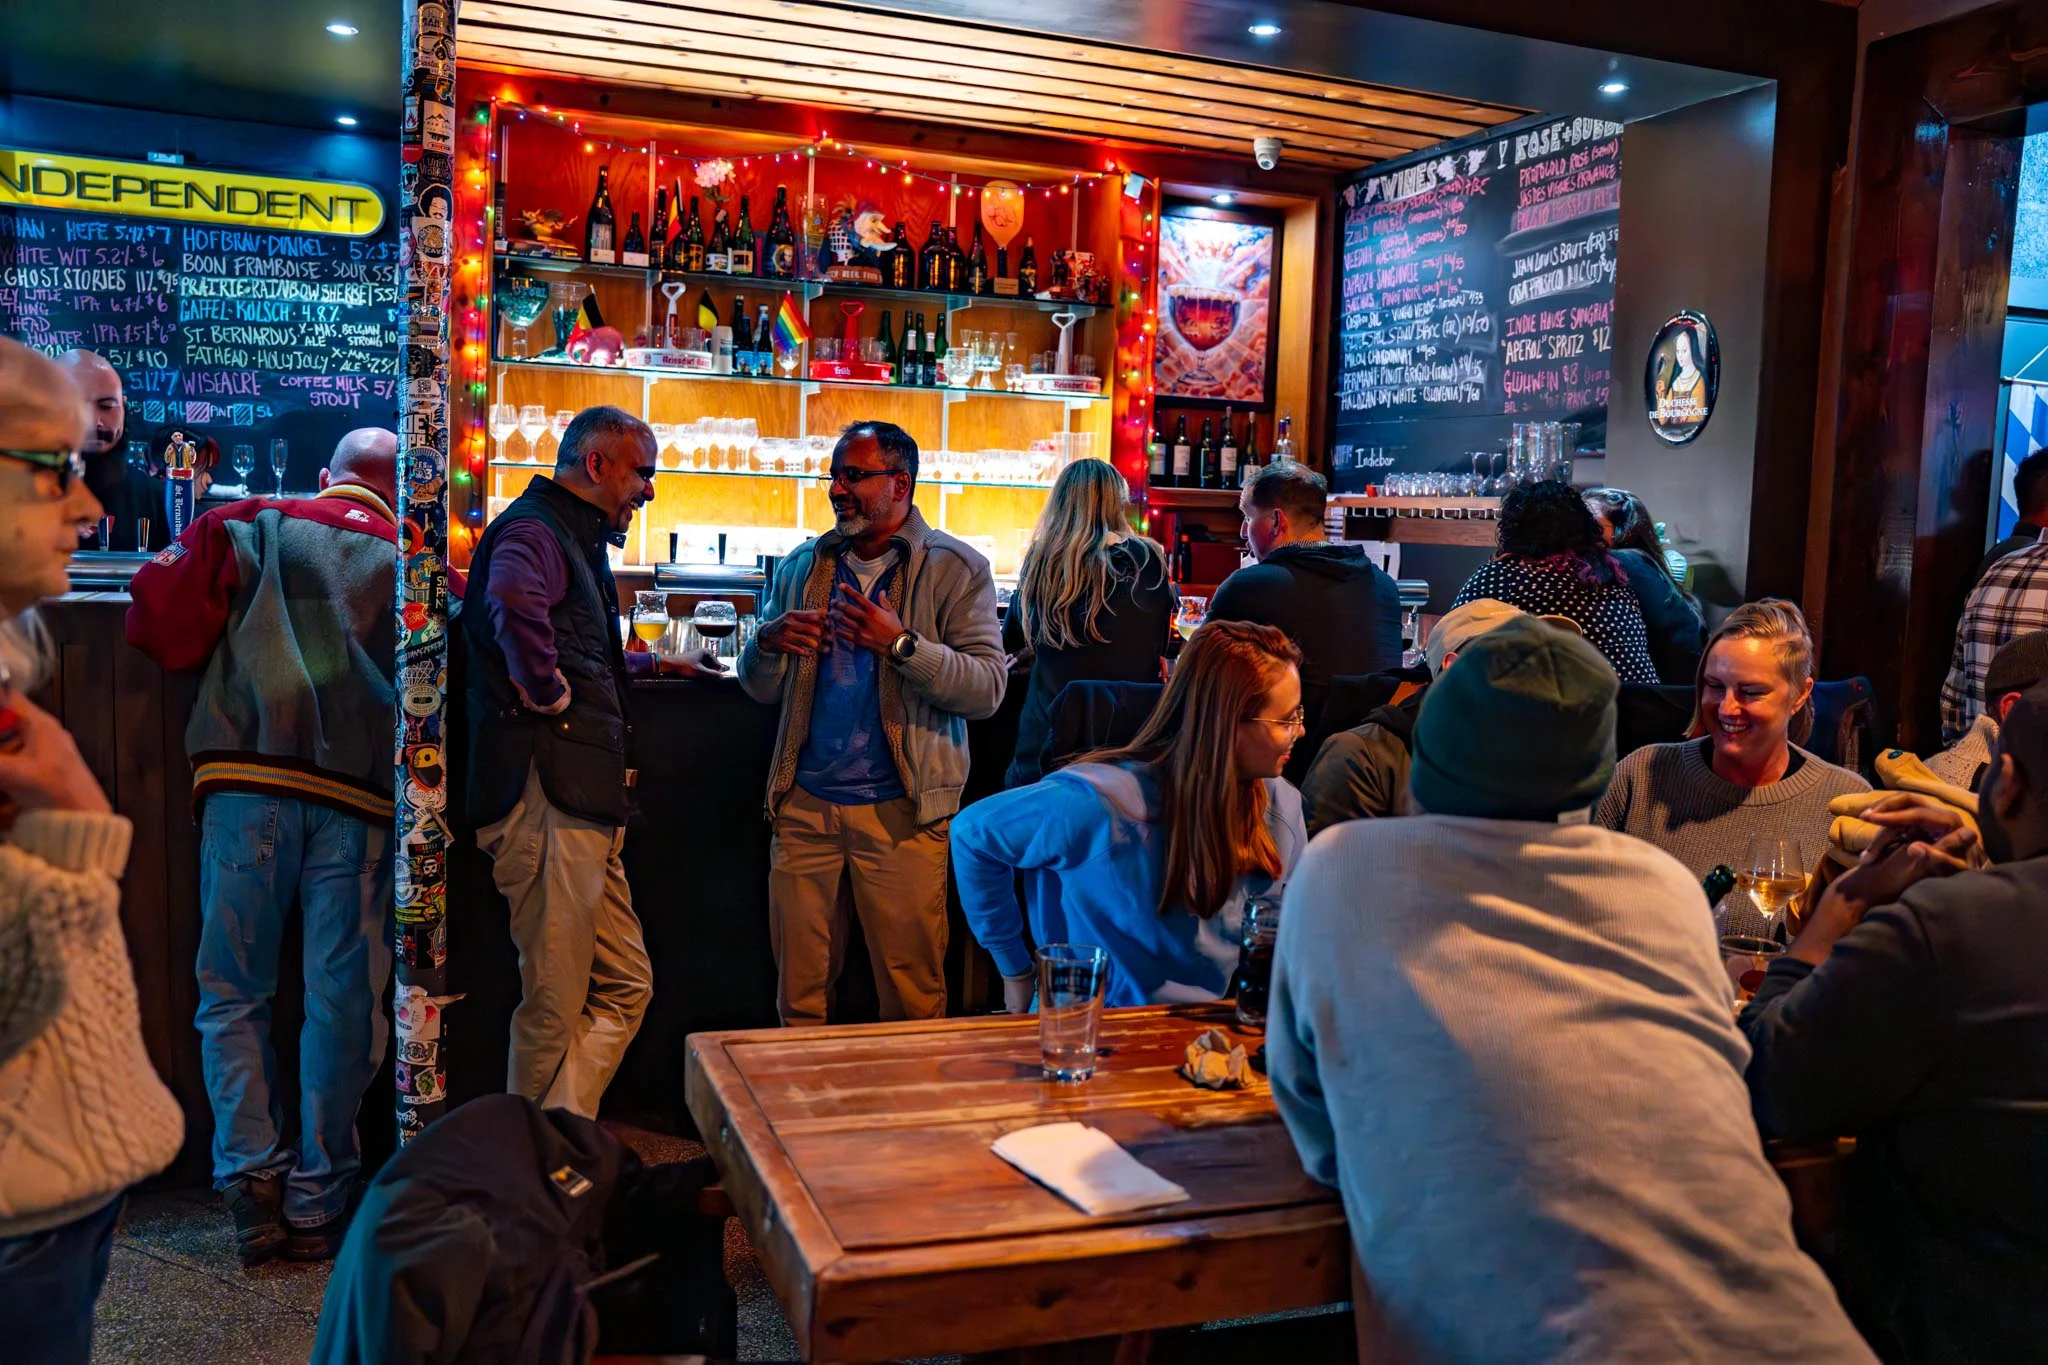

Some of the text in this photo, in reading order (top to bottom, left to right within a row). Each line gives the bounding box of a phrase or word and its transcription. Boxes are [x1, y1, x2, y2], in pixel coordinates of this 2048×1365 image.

[1380, 161, 1437, 201] WINES
[65, 220, 108, 242] HEFE
[58, 246, 87, 266] WIT
[182, 253, 226, 275] BOON
[232, 256, 321, 279] FRAMBOISE
[332, 261, 368, 284] SOUR
[4, 267, 59, 290] GHOST
[63, 268, 127, 292] STORIES
[180, 277, 247, 298] PRAIRIE
[2, 302, 49, 316] THING
[74, 296, 100, 311] IPA
[180, 300, 230, 322] GAFFEL
[302, 306, 340, 322] 4.8%
[11, 316, 51, 332] HEAD
[1506, 314, 1536, 337] INDIE
[1540, 309, 1567, 331] HOUSE
[27, 331, 84, 345] HUNTER
[93, 322, 120, 343] IPA
[211, 326, 296, 346] BERNARDUS
[304, 336, 383, 347] ALE STRONG
[1548, 334, 1584, 360] SPRITZ
[1592, 326, 1611, 352] $12
[186, 345, 248, 368] FATHEAD
[339, 361, 362, 372] ALE
[182, 371, 262, 396] WISEACRE
[279, 376, 332, 389] COFFEE
[335, 375, 368, 392] MILK
[310, 392, 361, 409] STOUT
[1392, 387, 1417, 404] WHITE
[1660, 407, 1709, 418] BOURGOGNE
[1355, 448, 1395, 468] Indiebar
